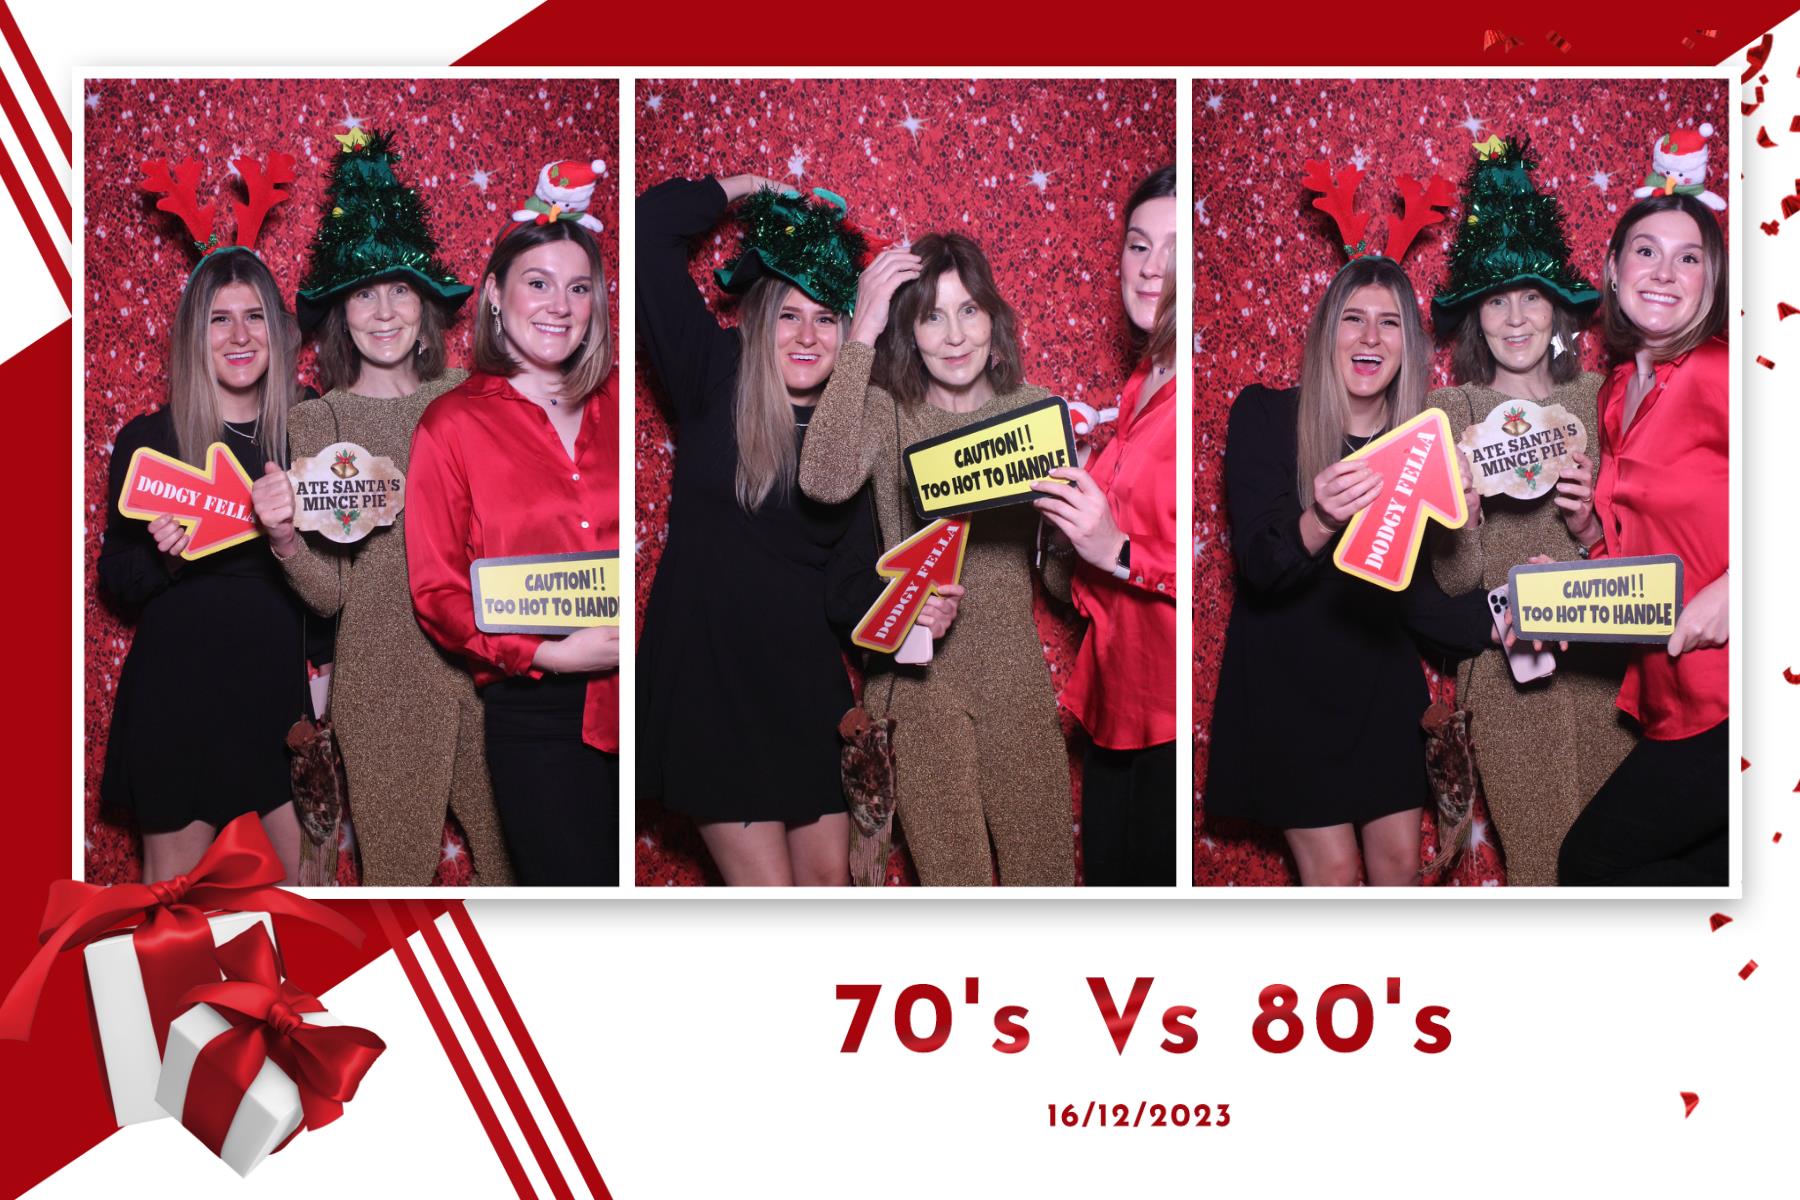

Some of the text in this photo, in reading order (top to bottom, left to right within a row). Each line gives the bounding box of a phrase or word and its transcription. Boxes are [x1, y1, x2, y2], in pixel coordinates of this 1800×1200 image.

[954, 424, 1034, 469] CAUTION!!
[1472, 423, 1578, 463] ATE SANTA'S
[1481, 442, 1568, 477] MINCE PIE
[136, 475, 202, 506] DODGY
[296, 478, 400, 495] ATE SANTA'S
[921, 482, 951, 500] TOO
[952, 471, 981, 495] HOT
[983, 466, 1004, 487] TO
[303, 494, 387, 511] MINCE PIE
[1364, 431, 1437, 570] DODGY FELLA
[525, 567, 606, 591] CAUTION!!
[874, 524, 960, 639] DODGY FELLA
[1563, 573, 1645, 599] CAUTION!!
[485, 596, 619, 618] TOO HOT TO HAND
[1522, 603, 1672, 626] TOO HOT TO HANDLE
